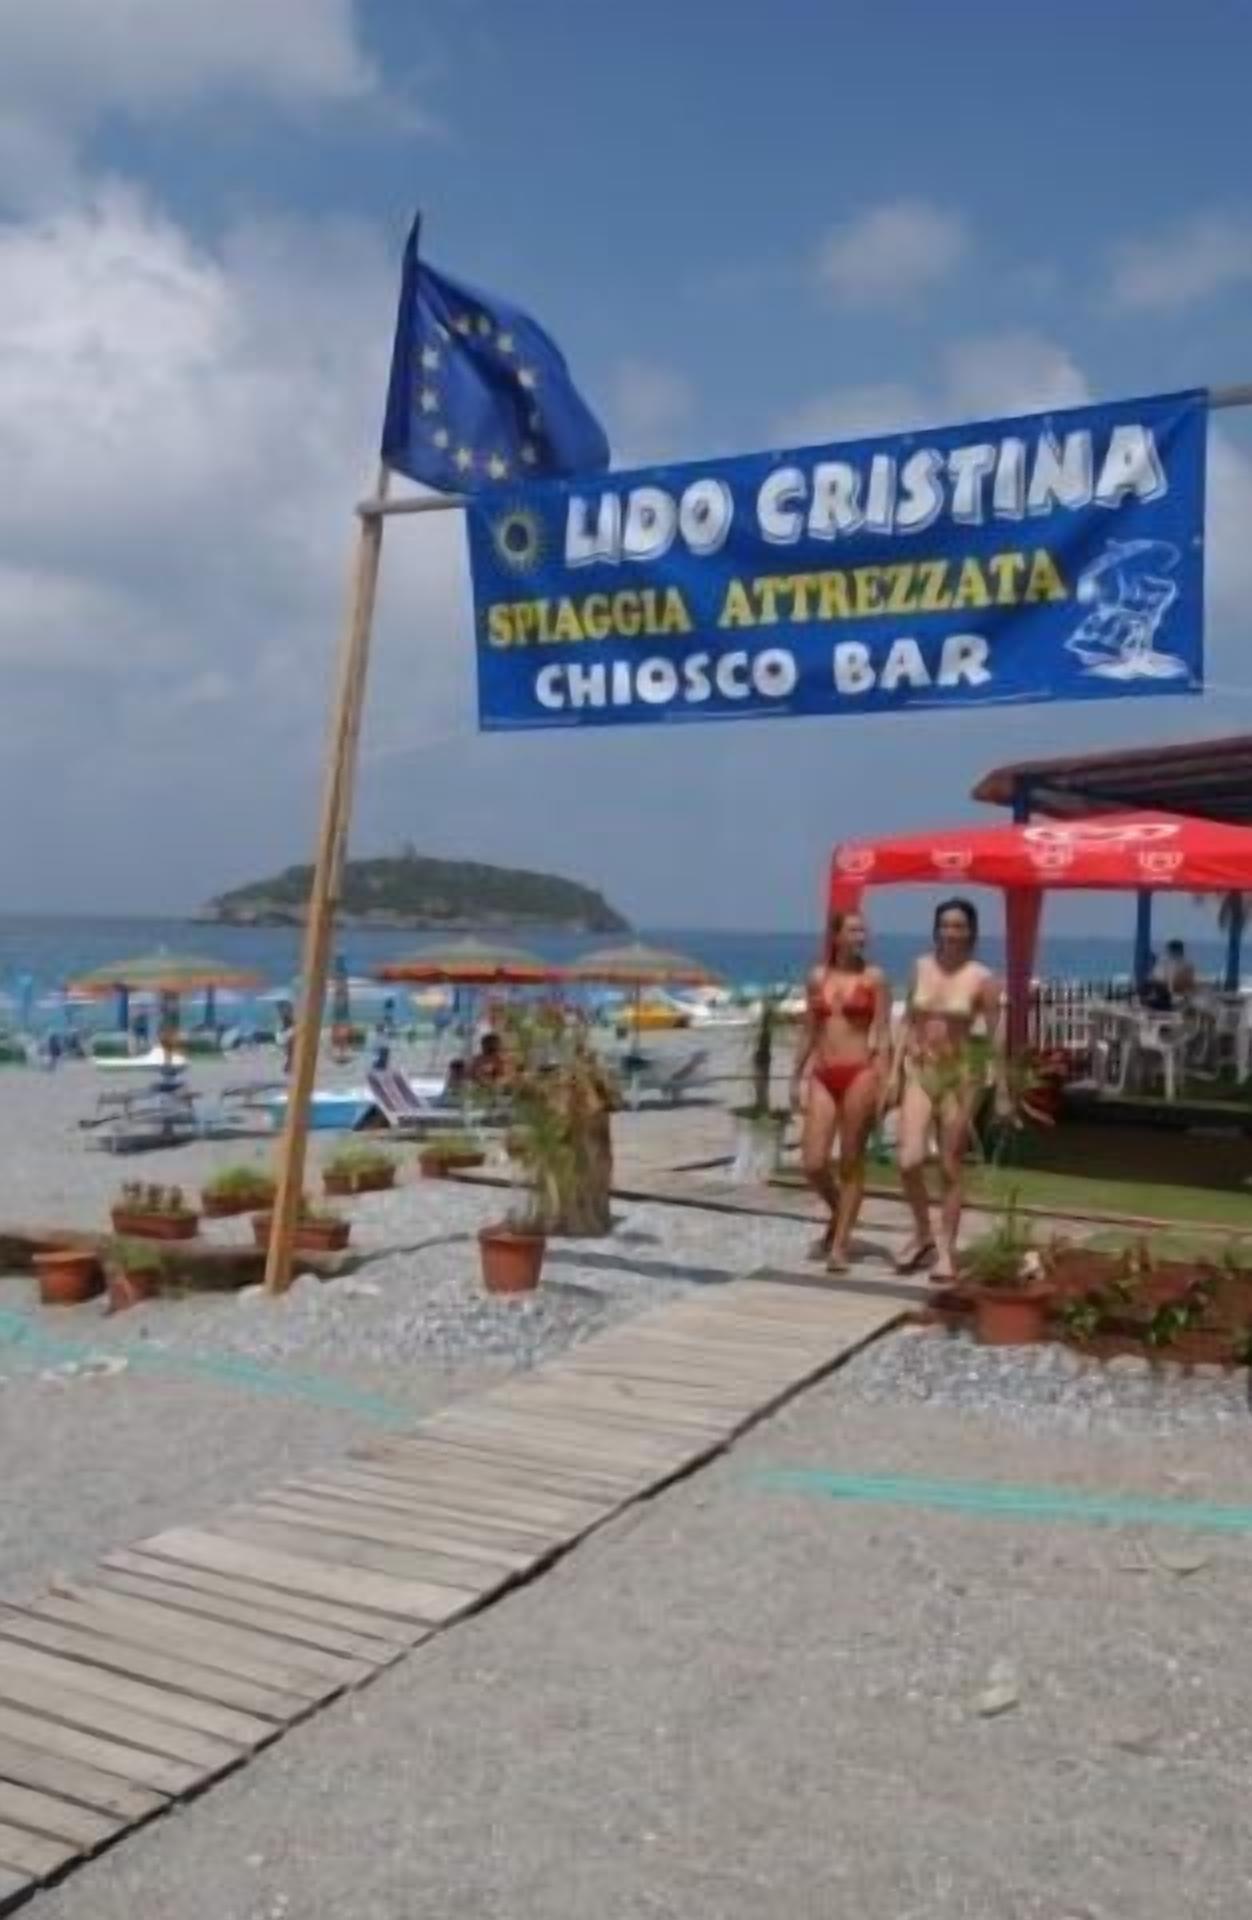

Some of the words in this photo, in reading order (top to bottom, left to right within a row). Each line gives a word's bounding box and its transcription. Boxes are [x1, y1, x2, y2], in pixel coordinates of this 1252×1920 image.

[565, 478, 734, 567] LIDO
[756, 424, 1168, 545] CRISTINA
[487, 586, 693, 648] SPIAGGIA
[718, 548, 1067, 628] ATTREZZATA
[535, 648, 797, 709] CHIOSCO
[833, 634, 992, 694] BAR
